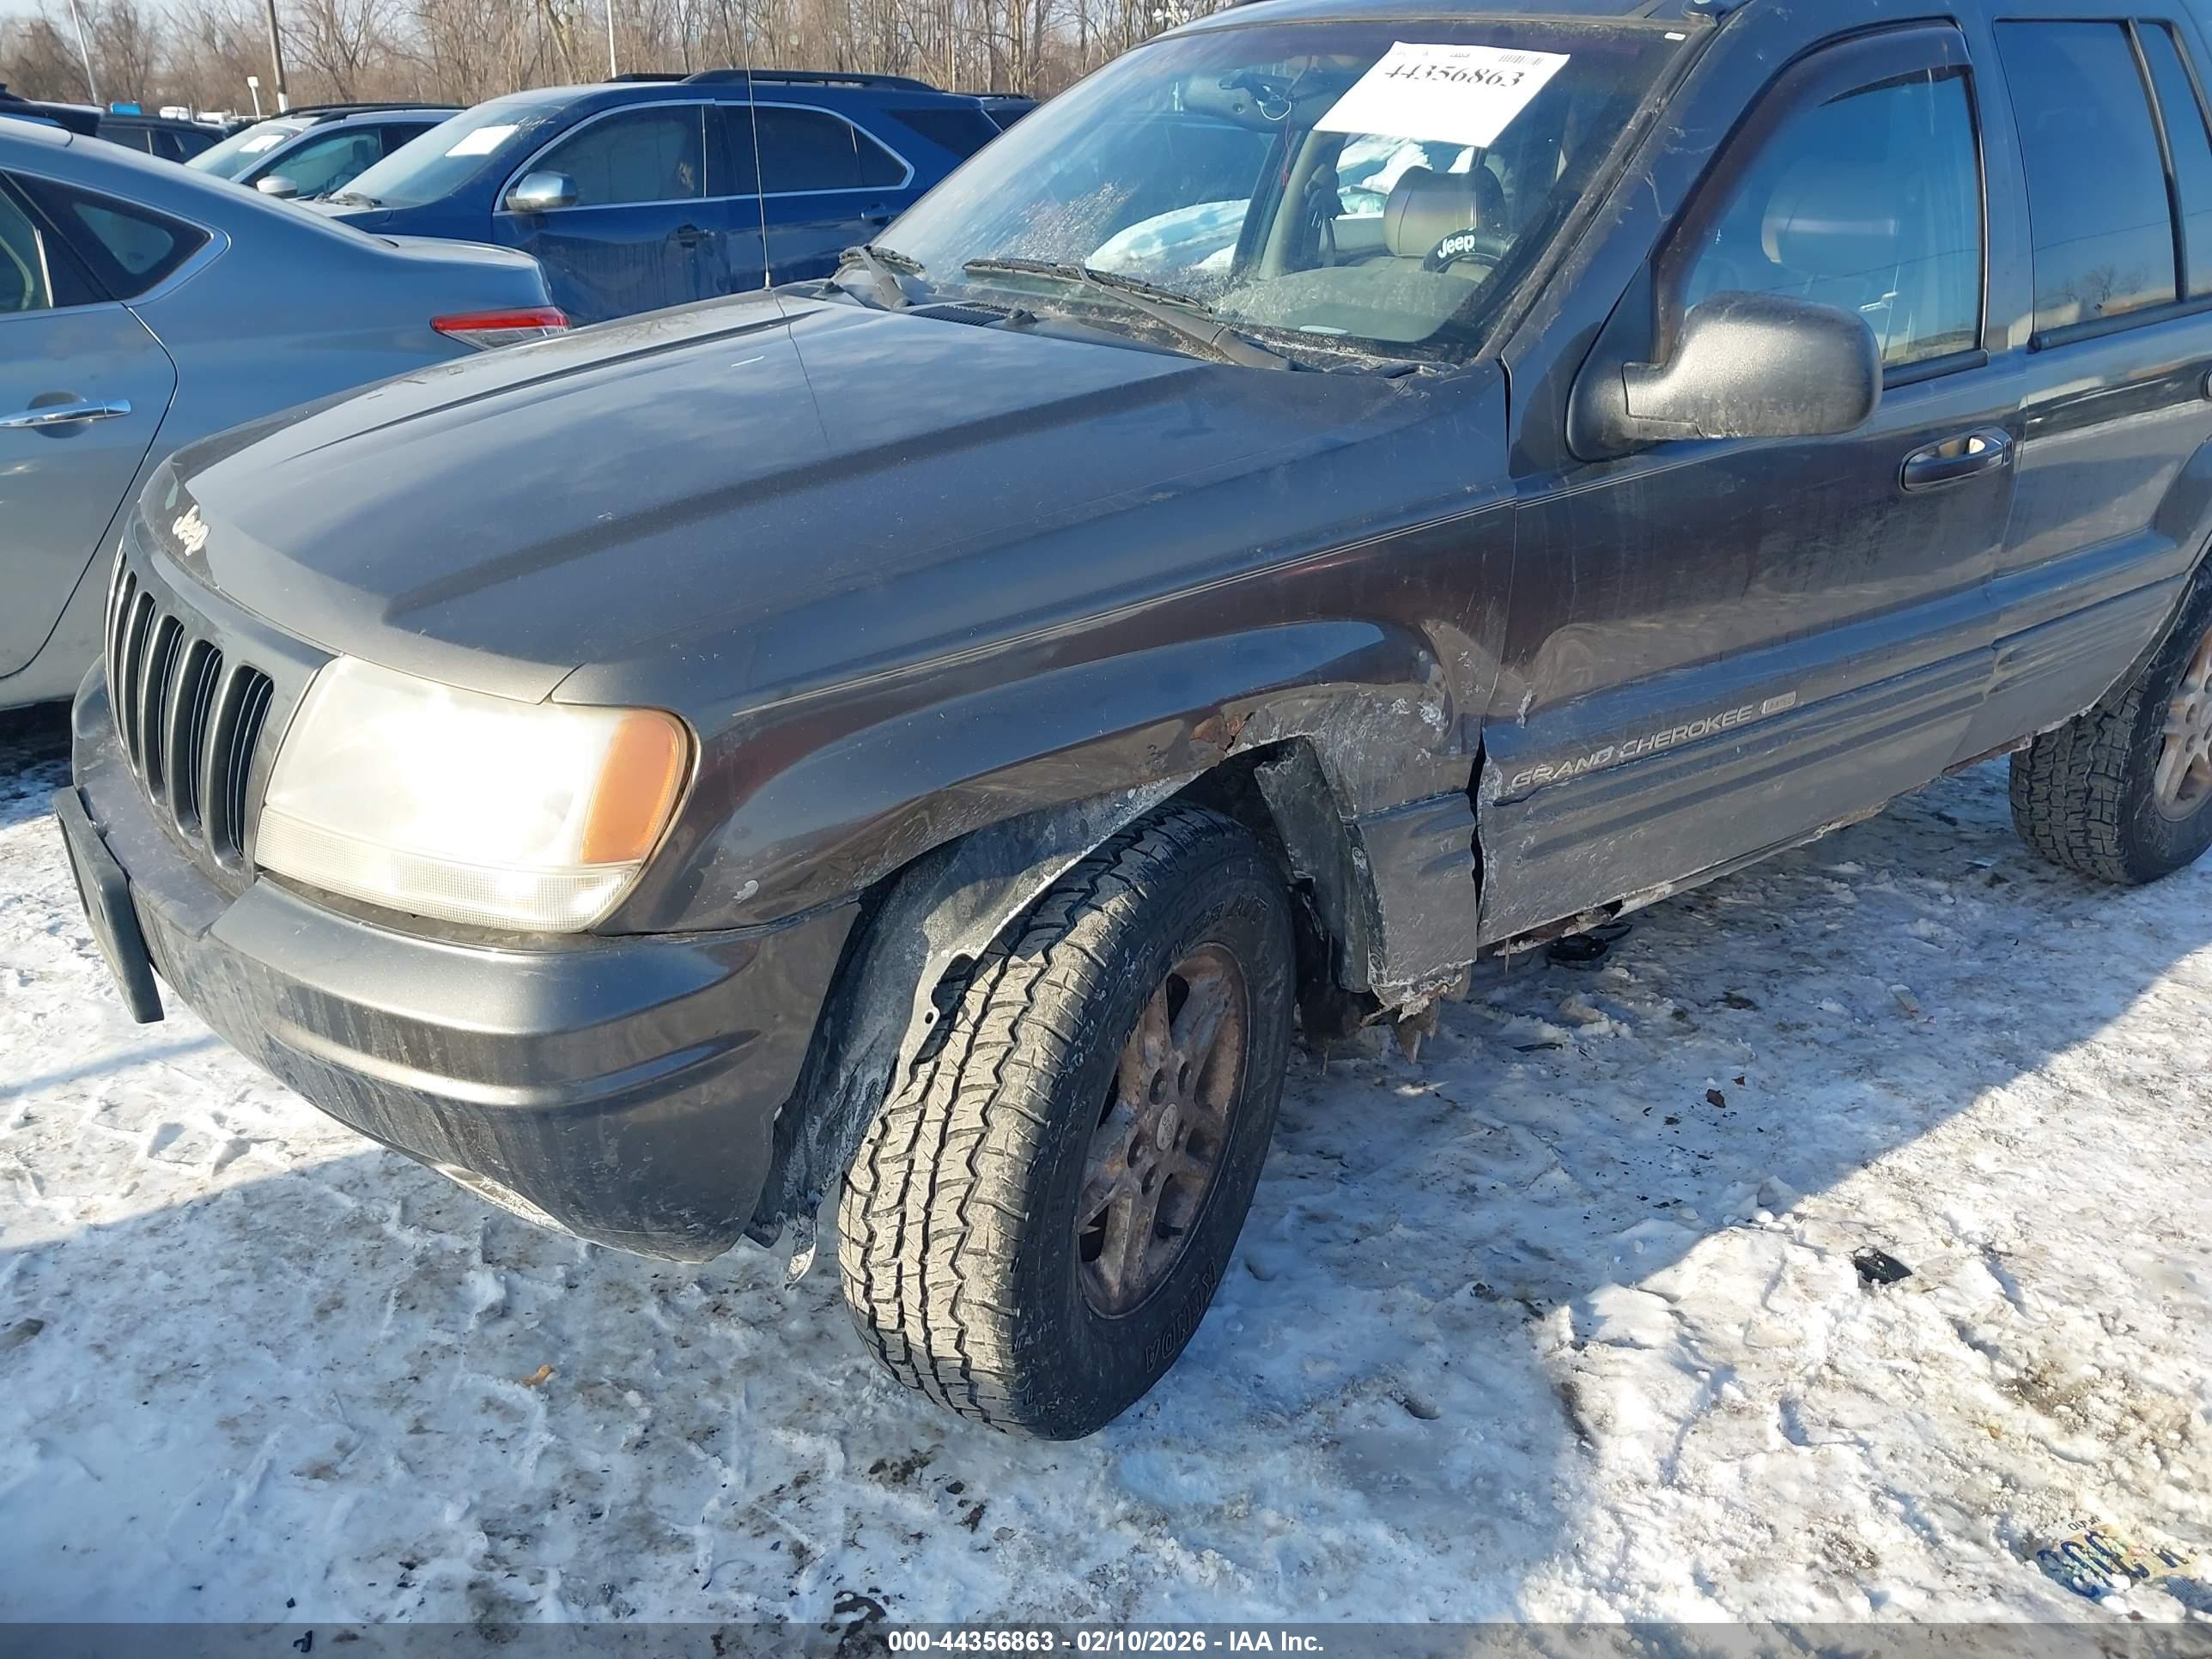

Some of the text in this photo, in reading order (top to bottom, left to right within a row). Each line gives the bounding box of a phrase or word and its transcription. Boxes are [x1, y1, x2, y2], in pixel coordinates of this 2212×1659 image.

[1384, 64, 1525, 87] 44356863
[1437, 234, 1475, 258] Jeep
[172, 504, 210, 556] Jeep
[1510, 703, 1753, 788] GRAND CHEROKEE
